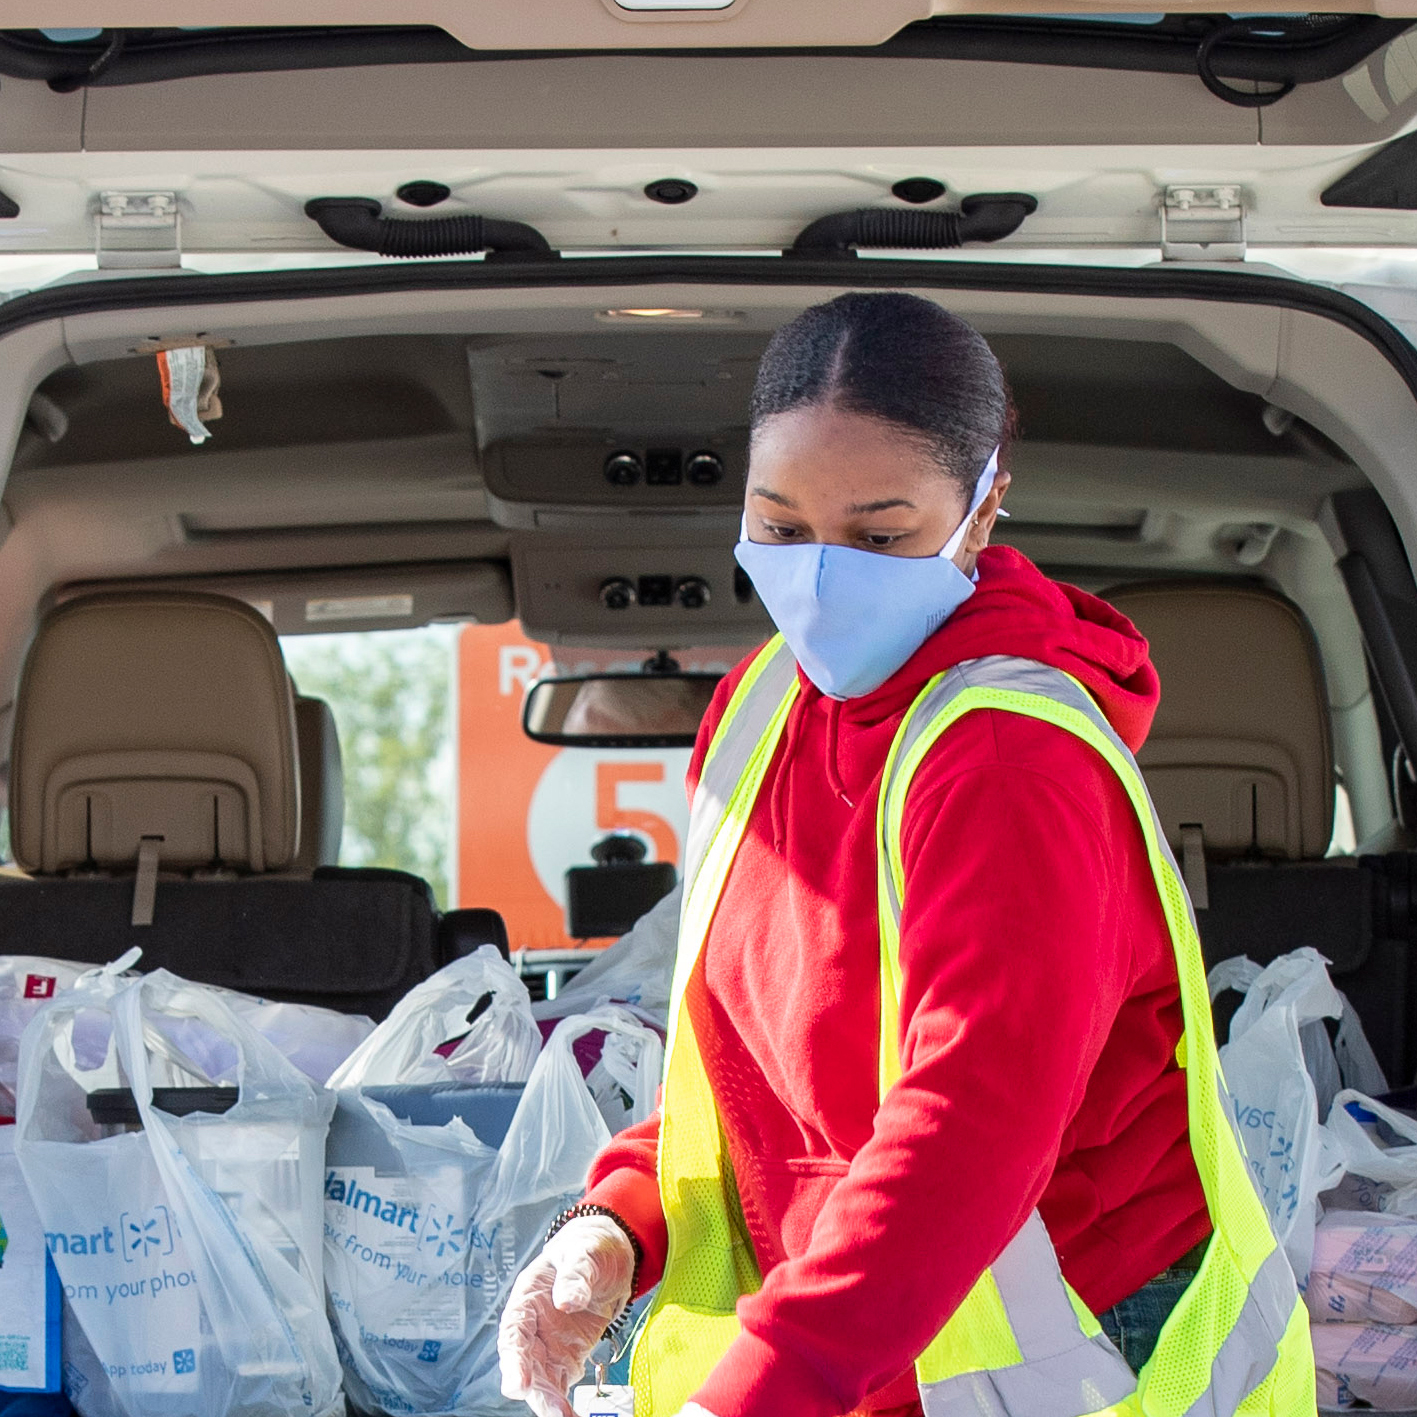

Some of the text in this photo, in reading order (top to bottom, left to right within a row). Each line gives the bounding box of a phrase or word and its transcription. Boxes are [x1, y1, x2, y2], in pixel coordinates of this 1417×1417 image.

[595, 761, 680, 867] 5
[44, 1226, 115, 1255] mart
[345, 1235, 391, 1271] from
[395, 1261, 428, 1287] your
[64, 1268, 197, 1305] om your pho
[383, 1333, 419, 1354] today
[131, 1359, 167, 1375] today
